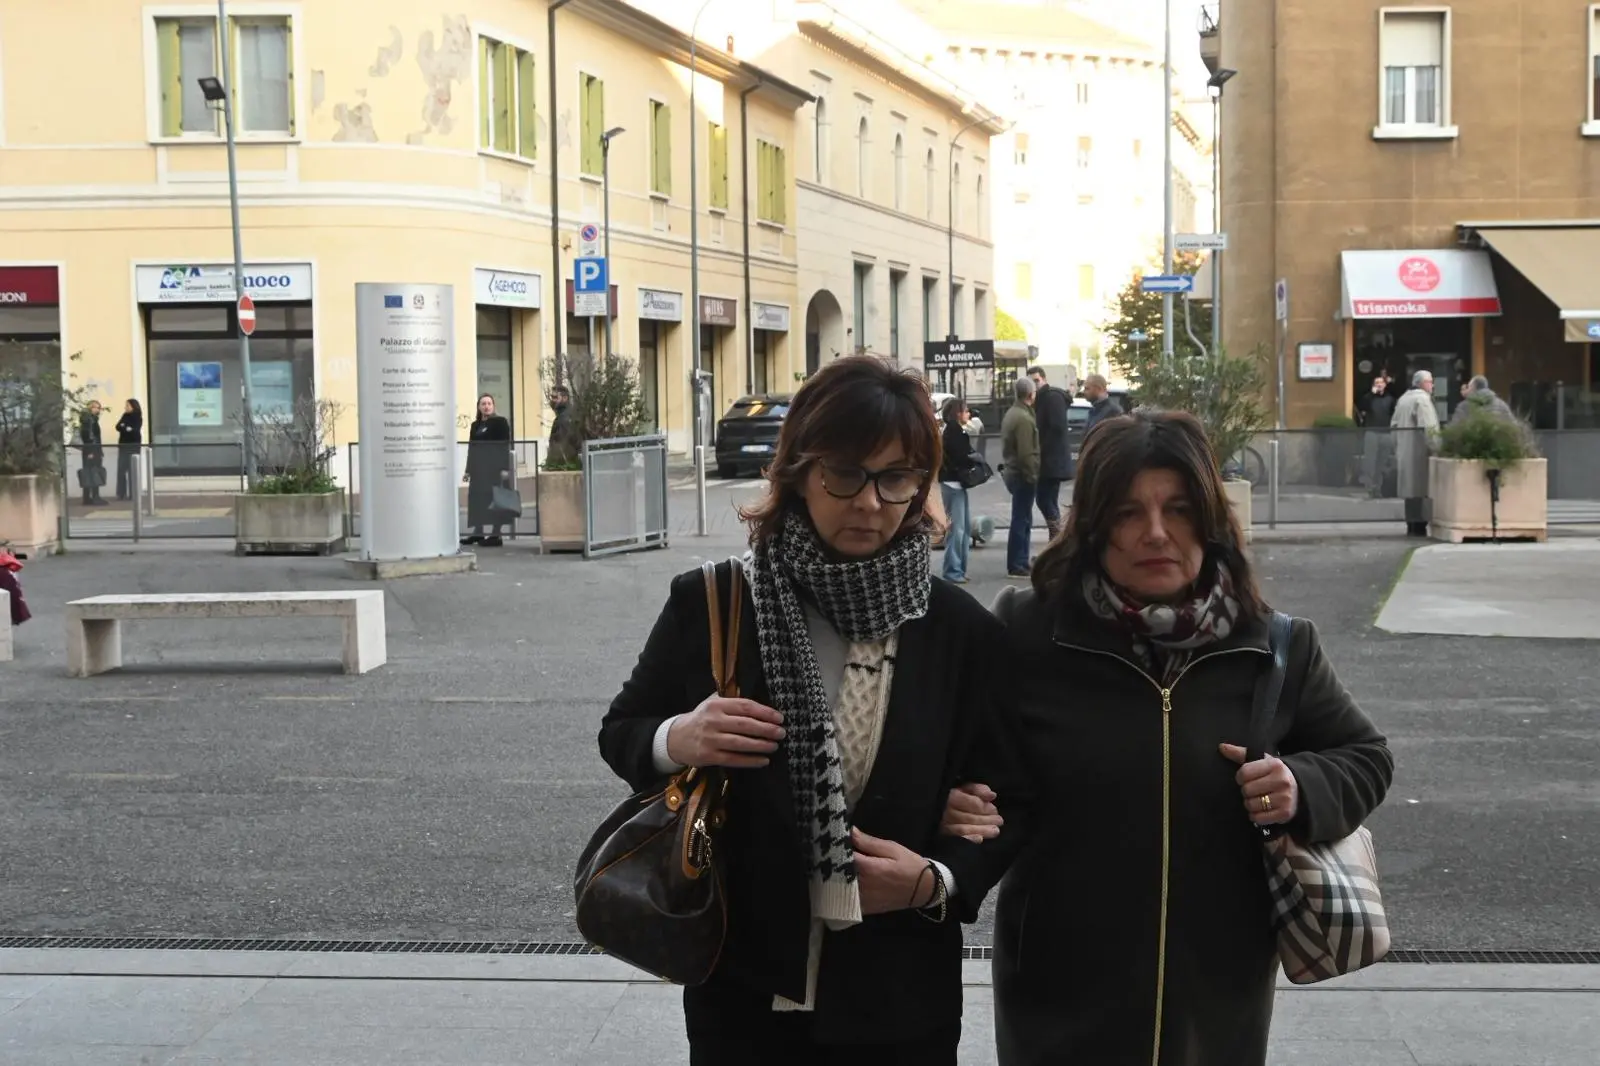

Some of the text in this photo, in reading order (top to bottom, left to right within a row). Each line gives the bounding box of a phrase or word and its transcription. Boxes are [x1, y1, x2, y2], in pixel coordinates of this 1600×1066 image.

[580, 261, 600, 289] P
[1357, 301, 1428, 314] trismoka
[380, 337, 412, 346] Palazzo
[935, 353, 983, 362] DA MINERVA
